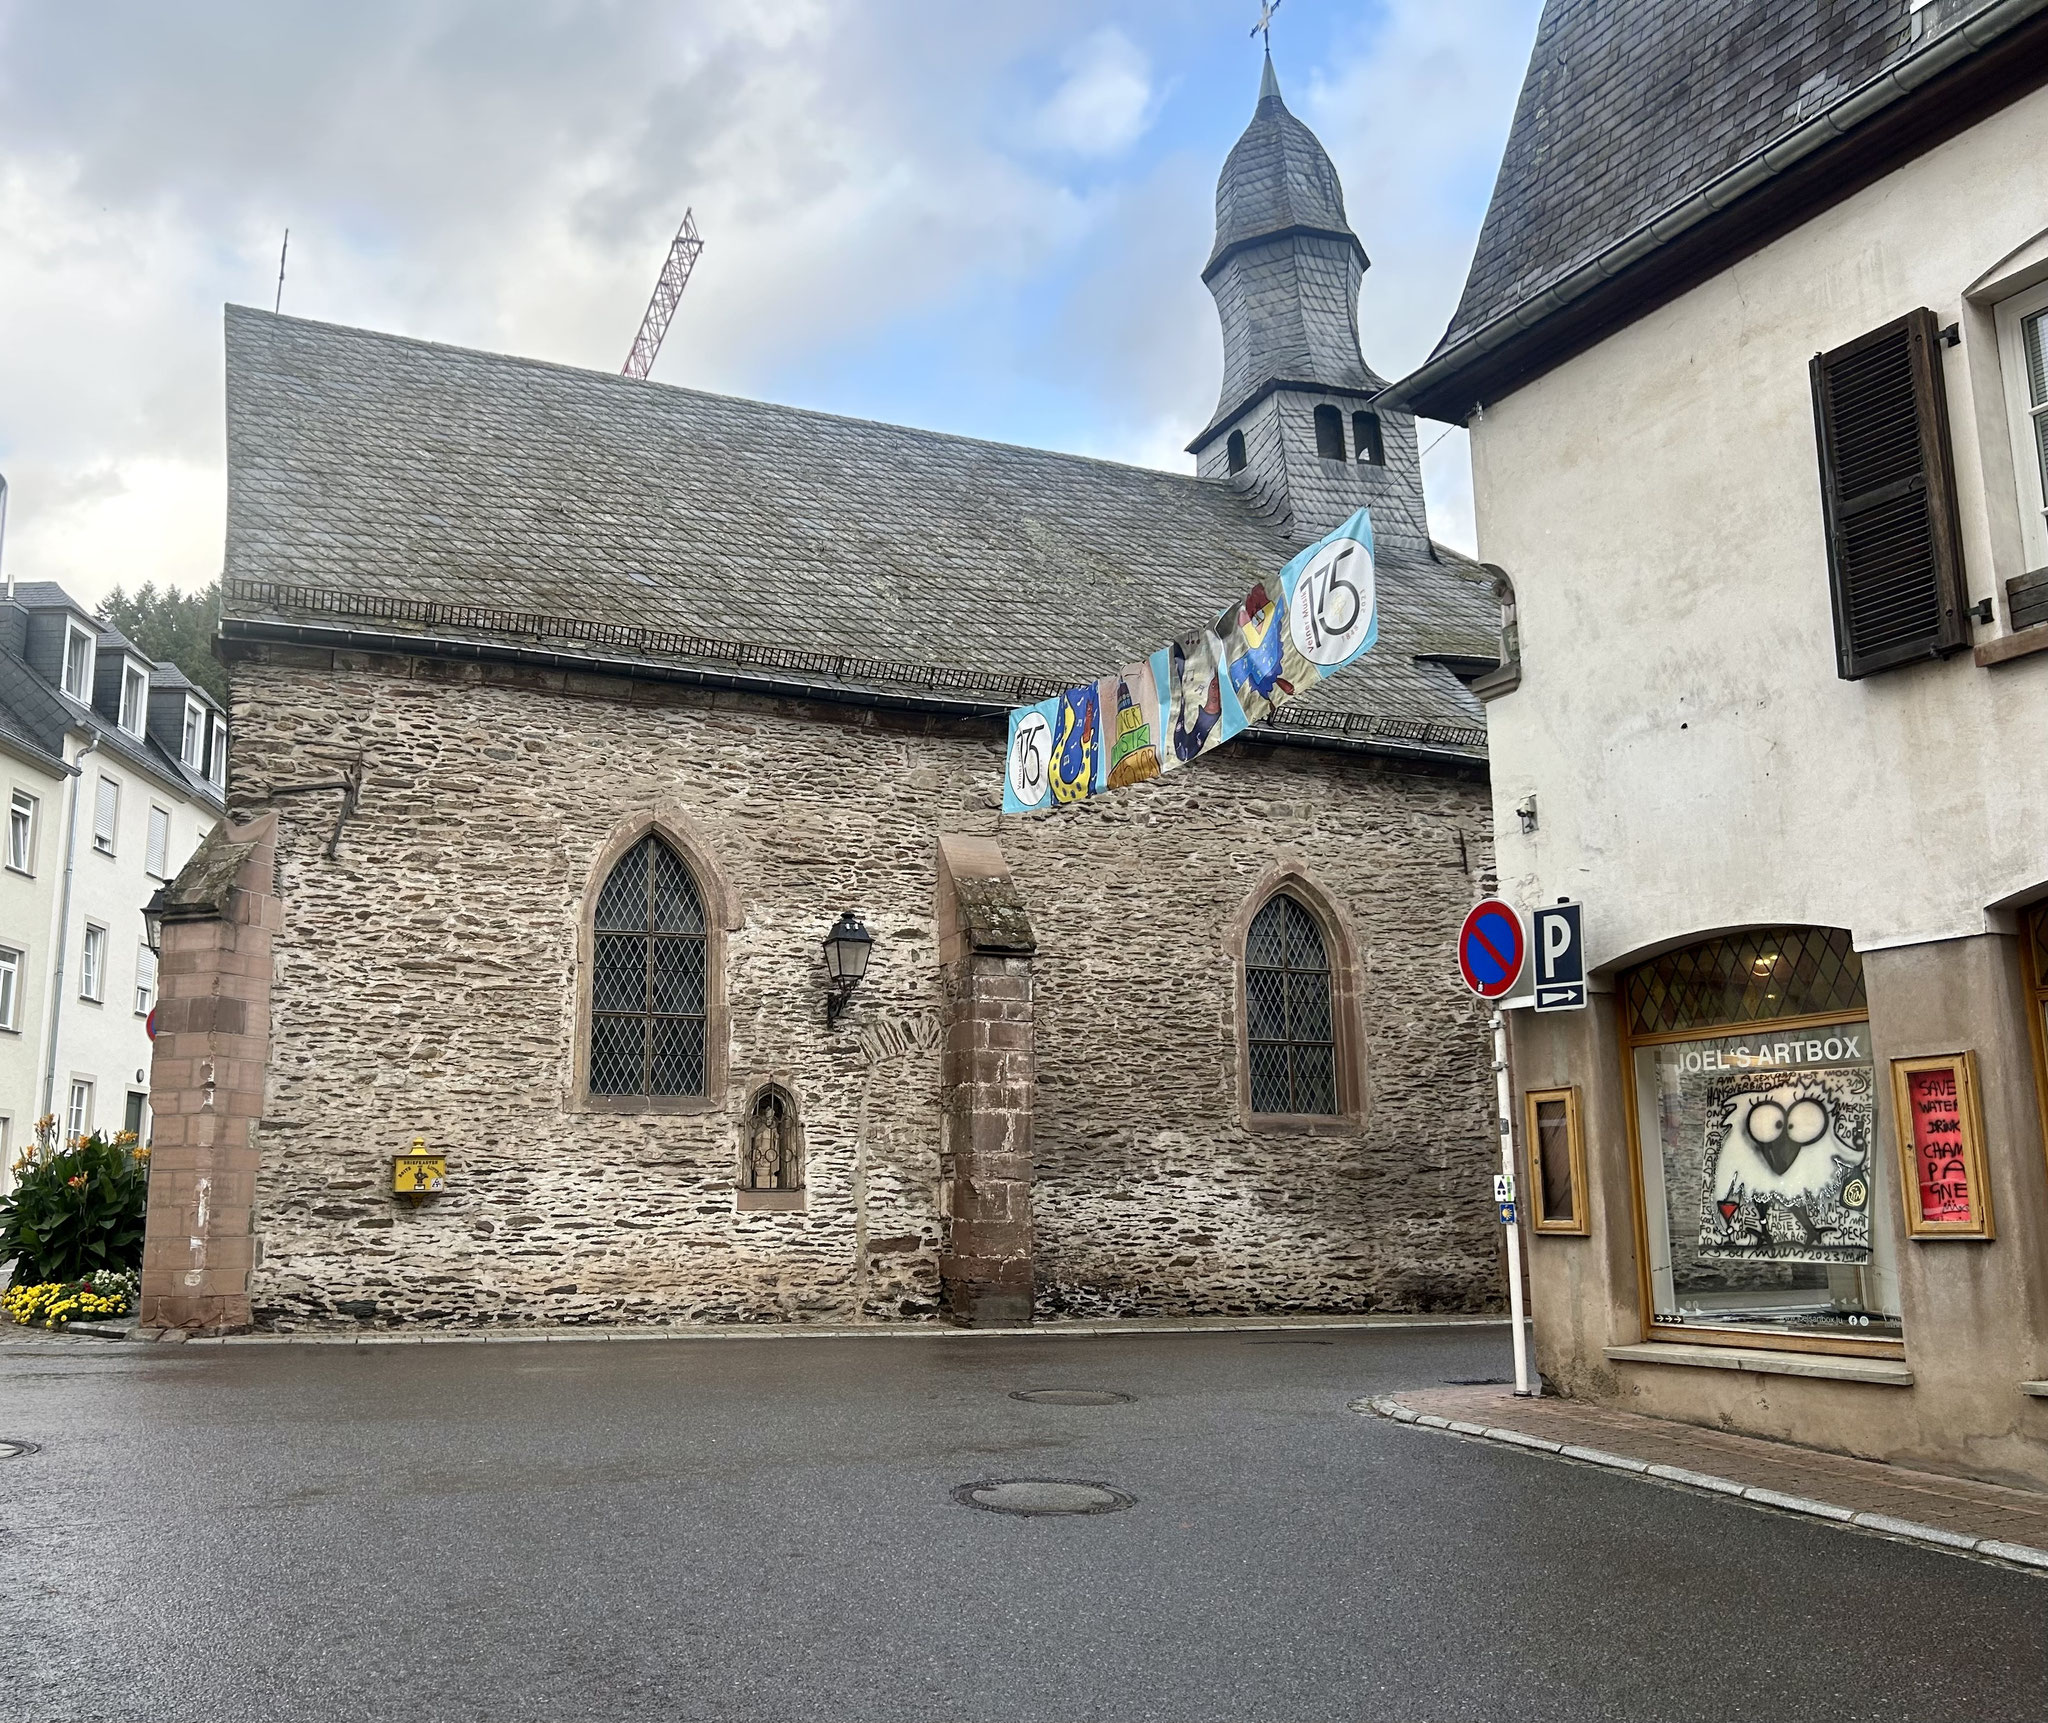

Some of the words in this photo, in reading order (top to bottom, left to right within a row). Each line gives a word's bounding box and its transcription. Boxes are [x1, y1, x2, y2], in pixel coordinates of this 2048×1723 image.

[1300, 546, 1360, 648] 175
[1543, 914, 1572, 979] P
[1757, 1036, 1861, 1066] ARTBOX
[1919, 1079, 1956, 1096] SAVE
[1927, 1119, 1960, 1134] DRINK
[1833, 1223, 1868, 1246] SPECK
[1807, 1249, 1840, 1261] 2023
